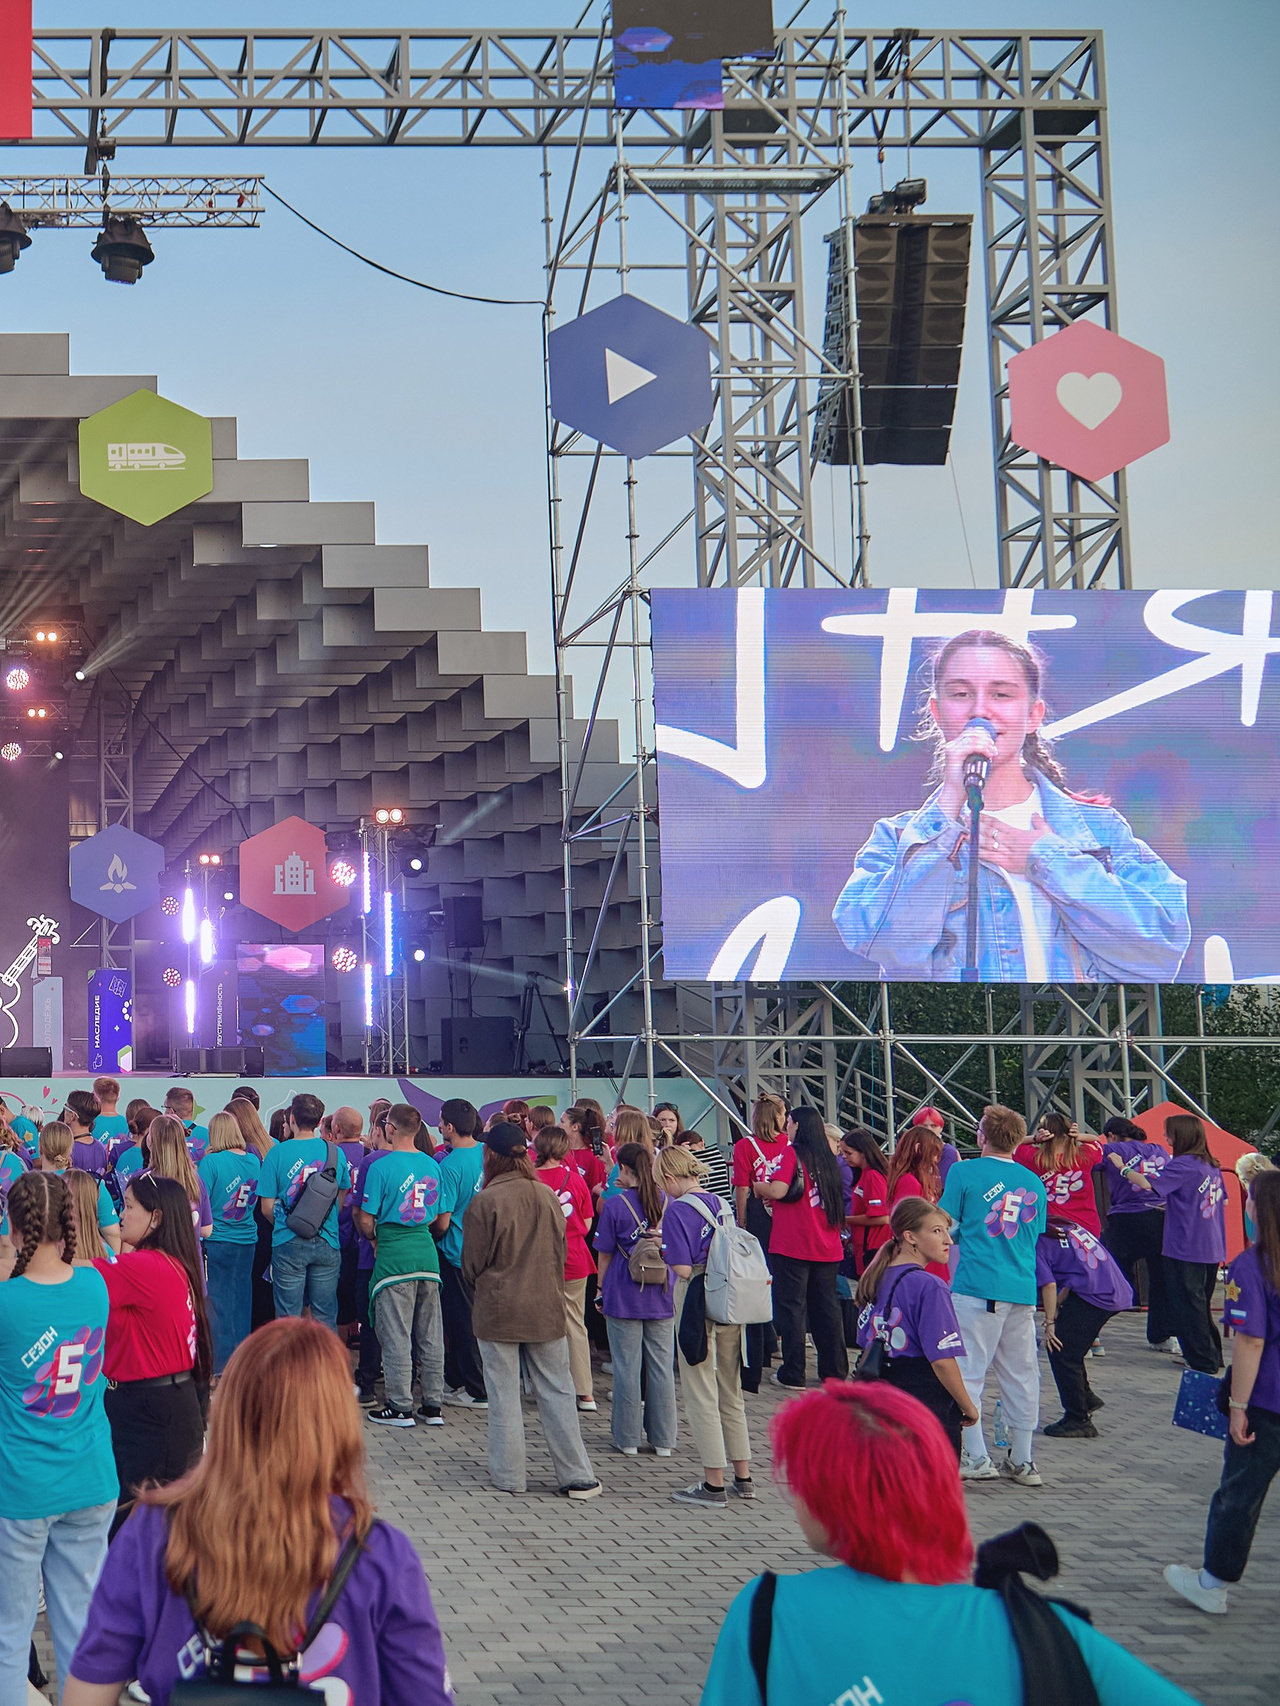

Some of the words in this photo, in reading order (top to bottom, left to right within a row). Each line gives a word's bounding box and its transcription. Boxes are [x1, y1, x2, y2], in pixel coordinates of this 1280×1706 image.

[44, 998, 52, 1047] ОЛОДЁЖЬ
[286, 1157, 305, 1180] СЕЗОН
[225, 1175, 241, 1194] СЕЗОН
[399, 1172, 415, 1193] СЕЗОН
[982, 1181, 1006, 1203] СЕЗОН
[1055, 1175, 1070, 1195] 5
[236, 1185, 251, 1208] 5
[413, 1183, 427, 1208] 5
[1002, 1194, 1023, 1222] 5
[21, 1325, 59, 1368] СЕЗОН
[54, 1343, 86, 1396] 5
